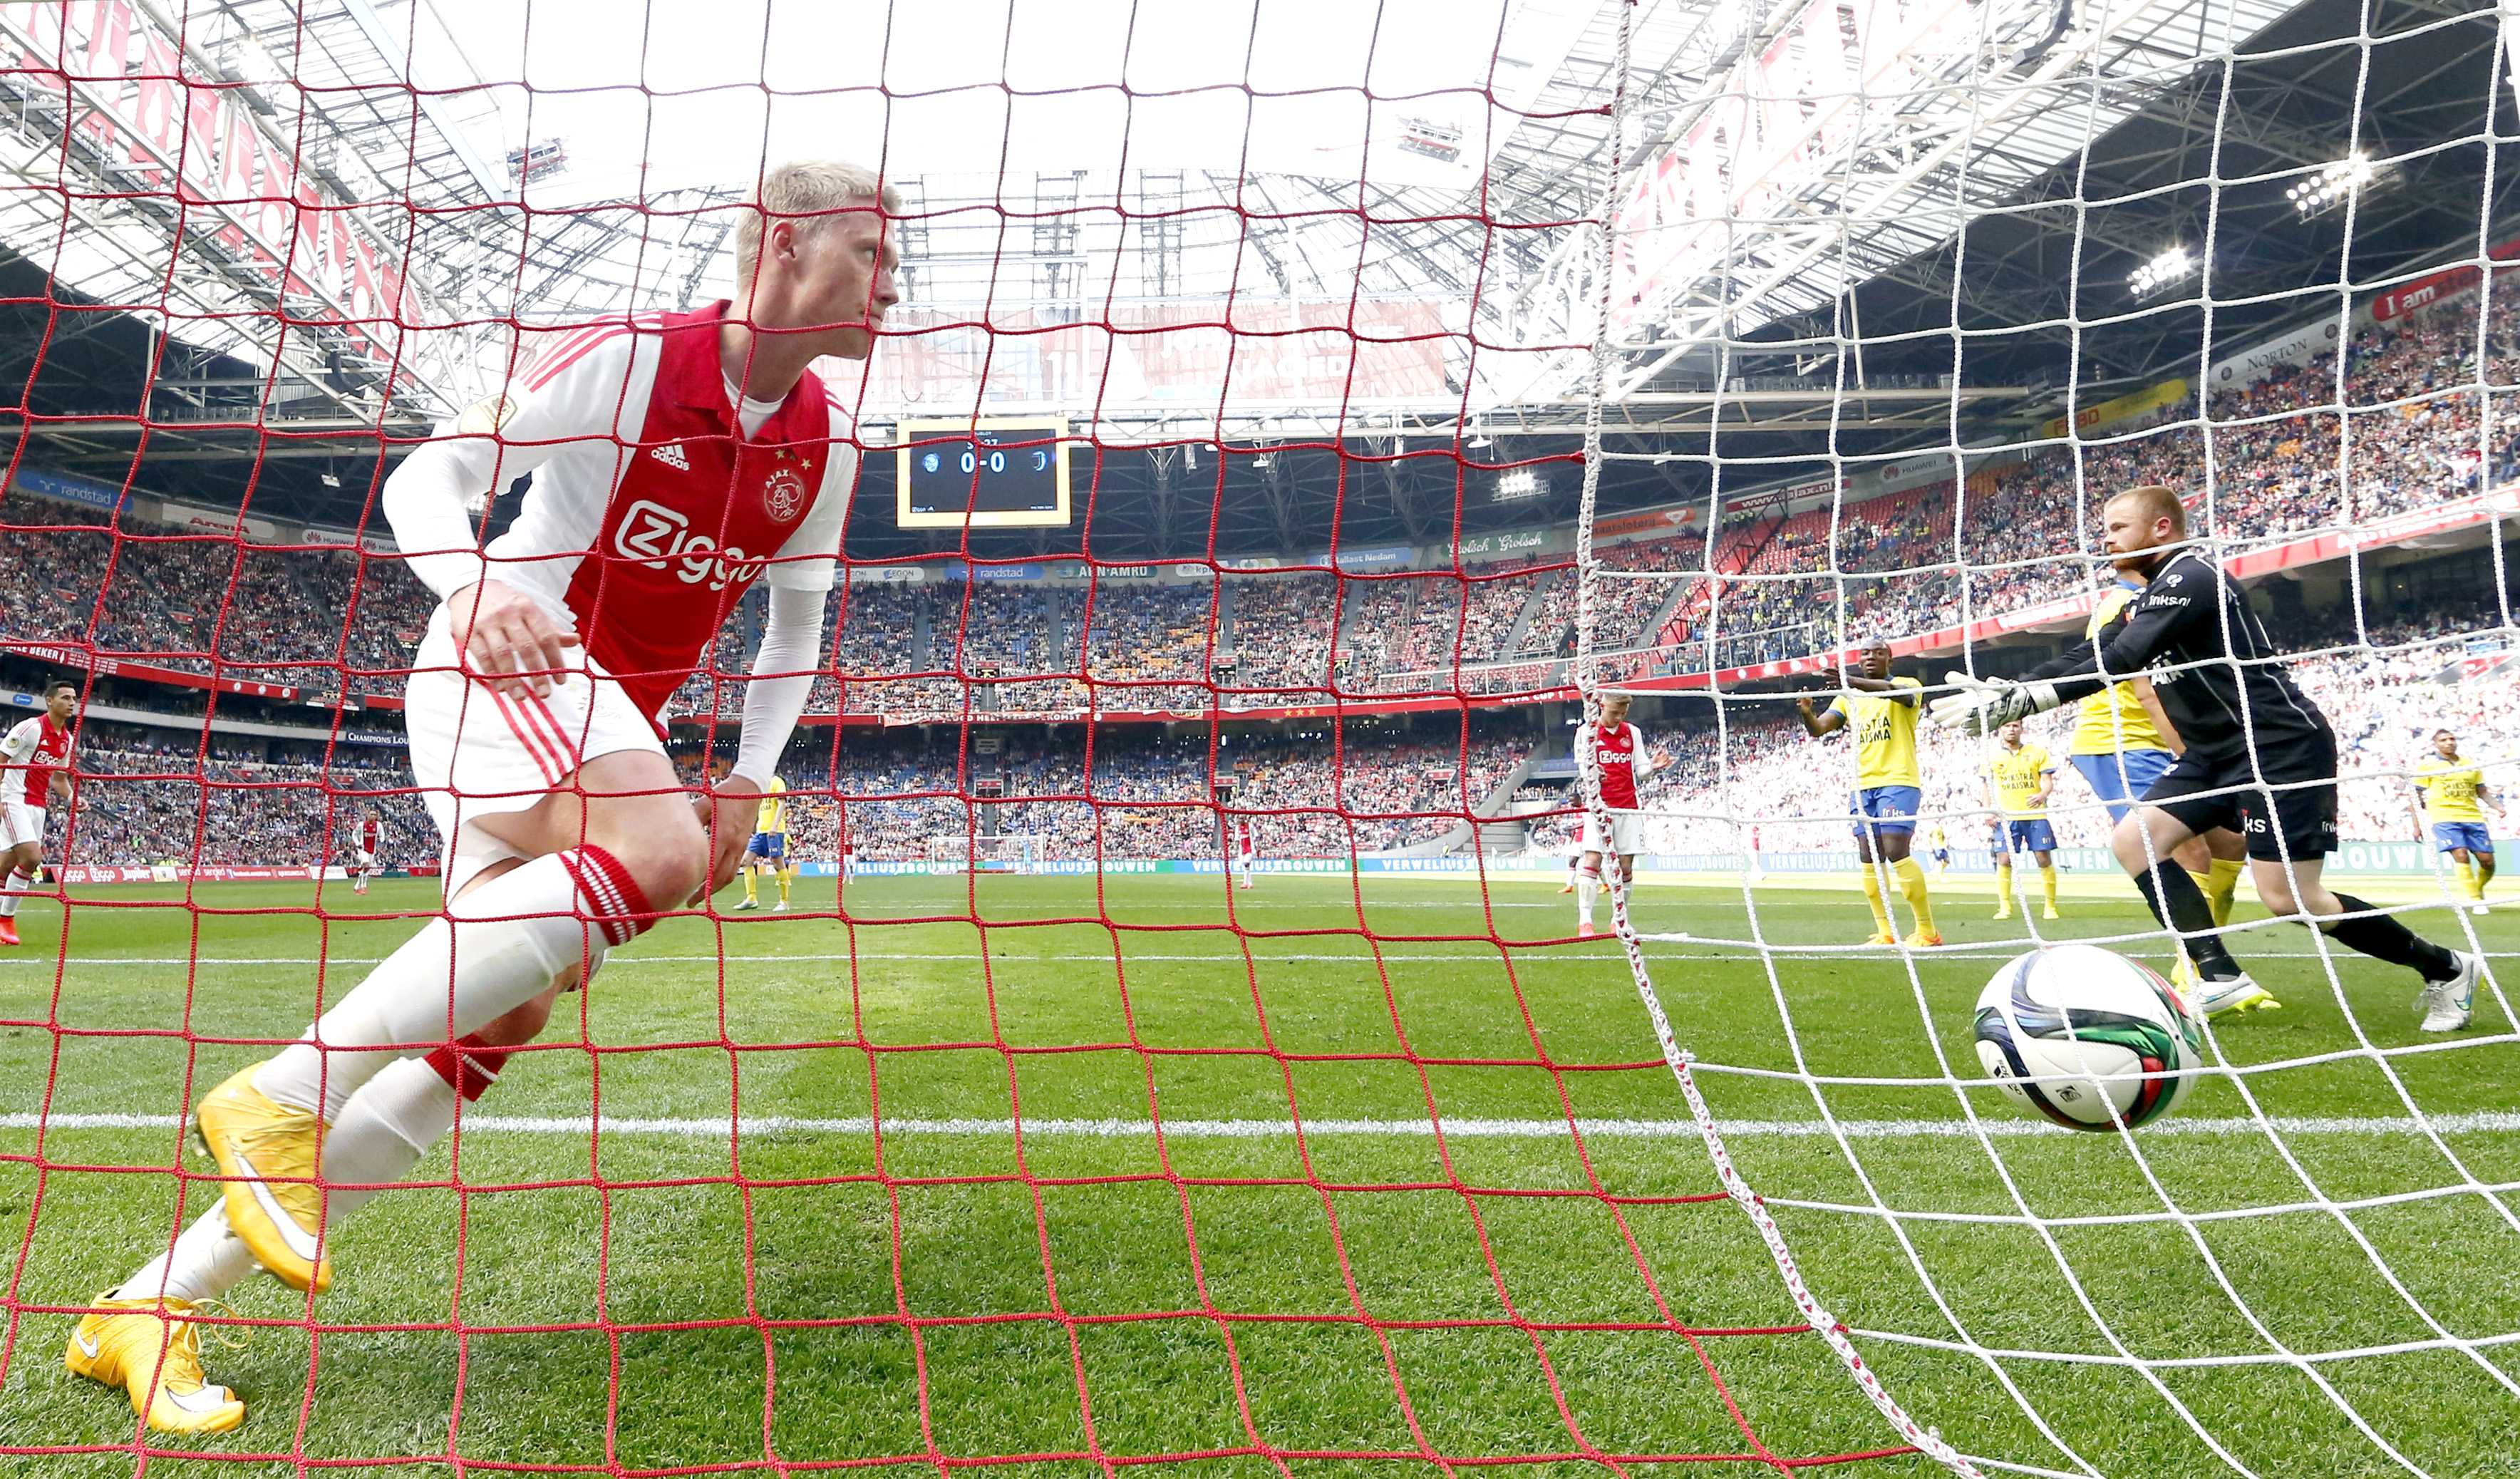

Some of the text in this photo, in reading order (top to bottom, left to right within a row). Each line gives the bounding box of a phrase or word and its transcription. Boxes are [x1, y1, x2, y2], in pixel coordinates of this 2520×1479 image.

[2247, 338, 2308, 371] NORTON
[651, 449, 690, 471] adidas
[765, 469, 790, 489] AJAX
[61, 484, 112, 505] randstad
[1499, 531, 1542, 552] Grolsch
[1365, 552, 1397, 562] Nedam
[980, 567, 1023, 577] randstad
[29, 646, 59, 660] BEKER
[348, 732, 391, 743] CHAMPIONS
[1859, 728, 1891, 744] AISMA
[1599, 750, 1632, 764] Ziggo
[1094, 861, 1157, 872] OUWEN
[1192, 860, 1346, 872] VERWEIUS BOUWEN
[1382, 858, 1537, 871] VERWELIUS OUWEN
[1656, 855, 1700, 870] VERWELIUS
[1767, 855, 1829, 870] VERWELIUS
[2025, 850, 2110, 870] BUWEN
